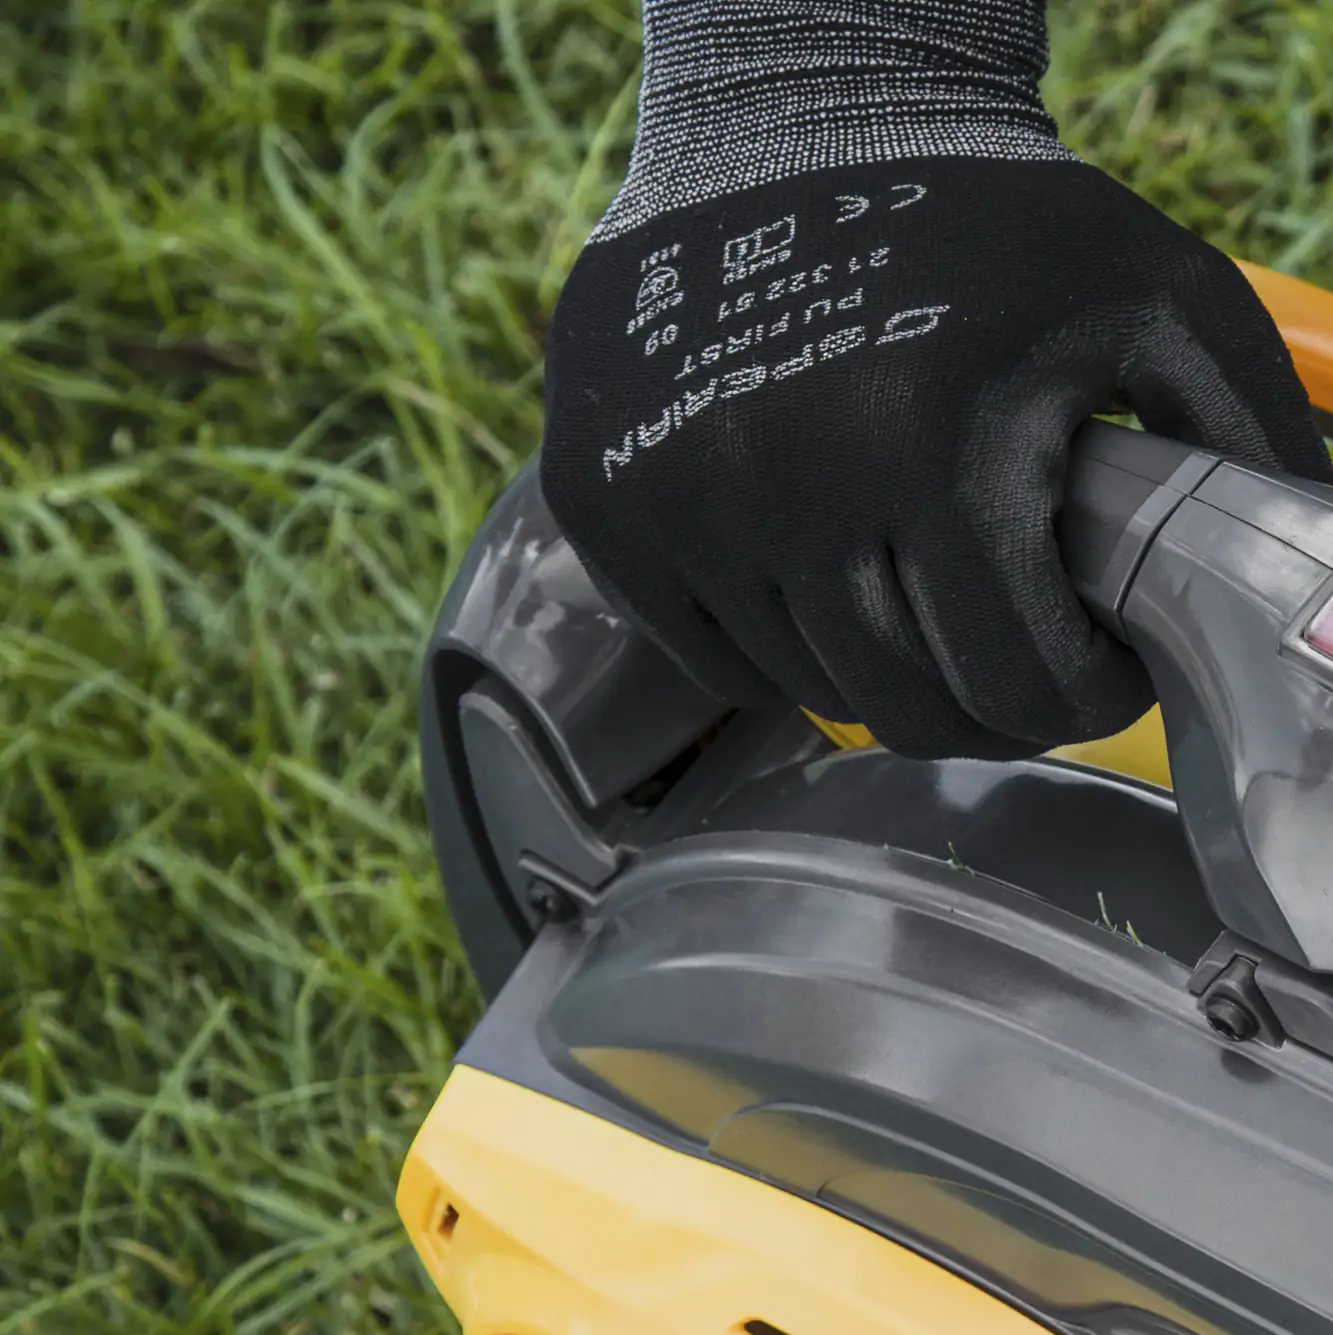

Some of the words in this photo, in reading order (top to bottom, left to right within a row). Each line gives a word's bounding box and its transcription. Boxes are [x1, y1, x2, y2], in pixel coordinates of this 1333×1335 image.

[848, 247, 890, 273] 21
[767, 264, 831, 300] 322
[718, 291, 755, 321] 51
[803, 287, 863, 323] PU
[644, 324, 679, 356] 09
[674, 312, 790, 380] FIRST
[603, 325, 866, 481] SPERIAN
